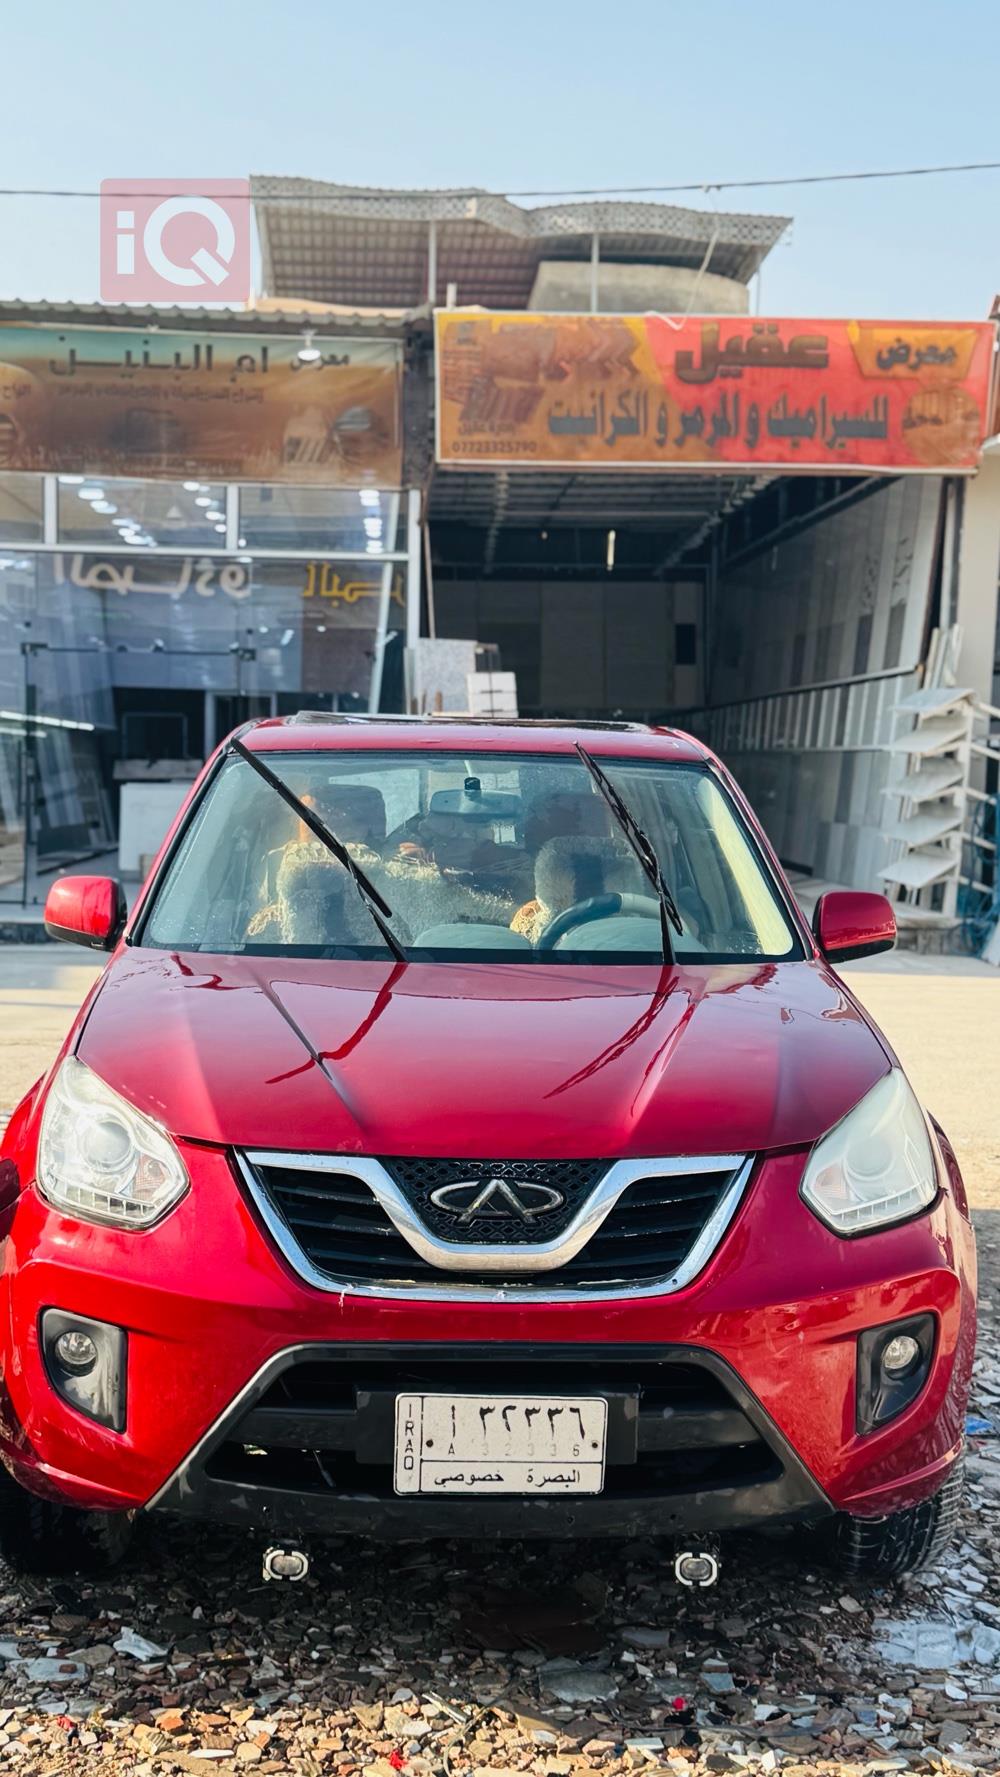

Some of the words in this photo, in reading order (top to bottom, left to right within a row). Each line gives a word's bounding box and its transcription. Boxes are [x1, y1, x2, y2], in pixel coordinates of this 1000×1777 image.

[50, 335, 213, 380] البنين
[674, 322, 829, 384] عقيل
[876, 337, 958, 370] معرض
[656, 402, 668, 448] و
[674, 389, 740, 448] المرمر
[744, 402, 760, 448] و
[767, 393, 888, 449] للسيراميك
[404, 1403, 415, 1470] IRAQ
[434, 1469, 505, 1488] خصوصي
[526, 1469, 581, 1488] البصرة
